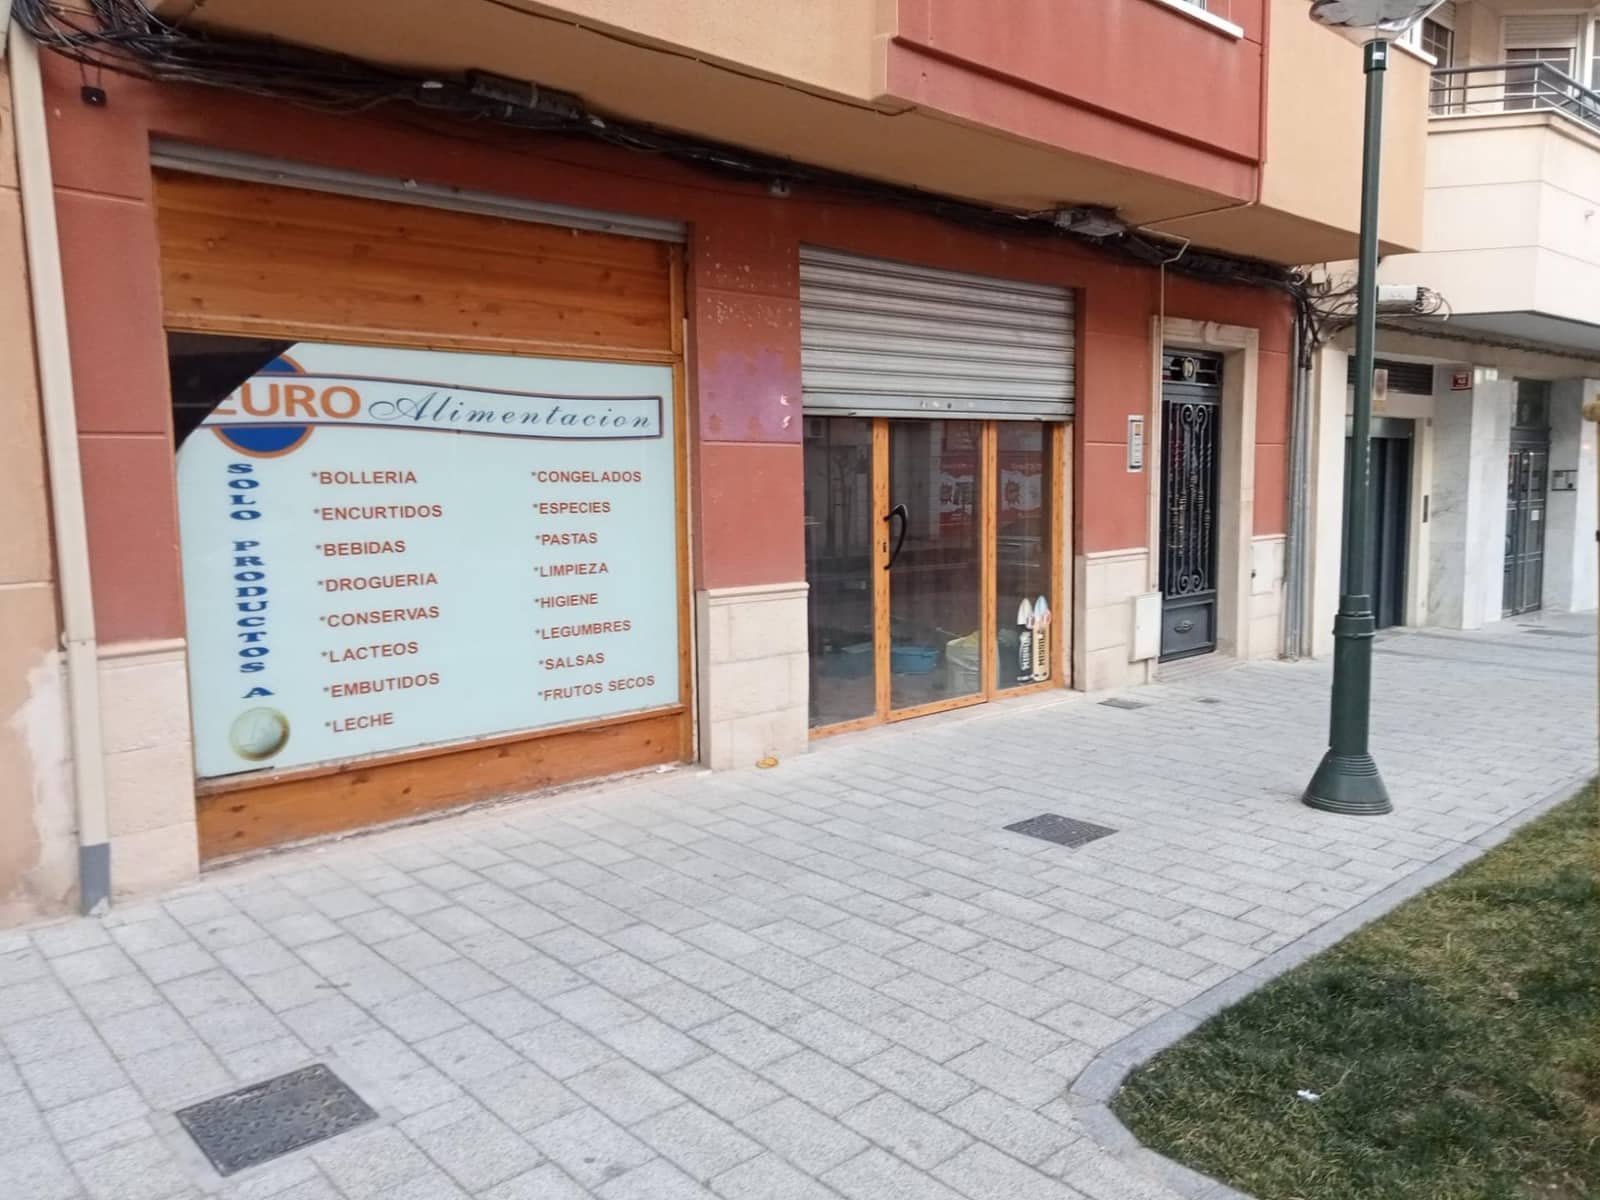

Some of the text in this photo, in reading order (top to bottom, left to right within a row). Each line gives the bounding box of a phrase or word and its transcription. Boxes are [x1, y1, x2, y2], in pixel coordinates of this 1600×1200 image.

[368, 391, 653, 428] Alimentacion
[226, 462, 262, 521] SOLO
[232, 540, 271, 674] PRODUCTOS
[608, 674, 656, 692] SECOS
